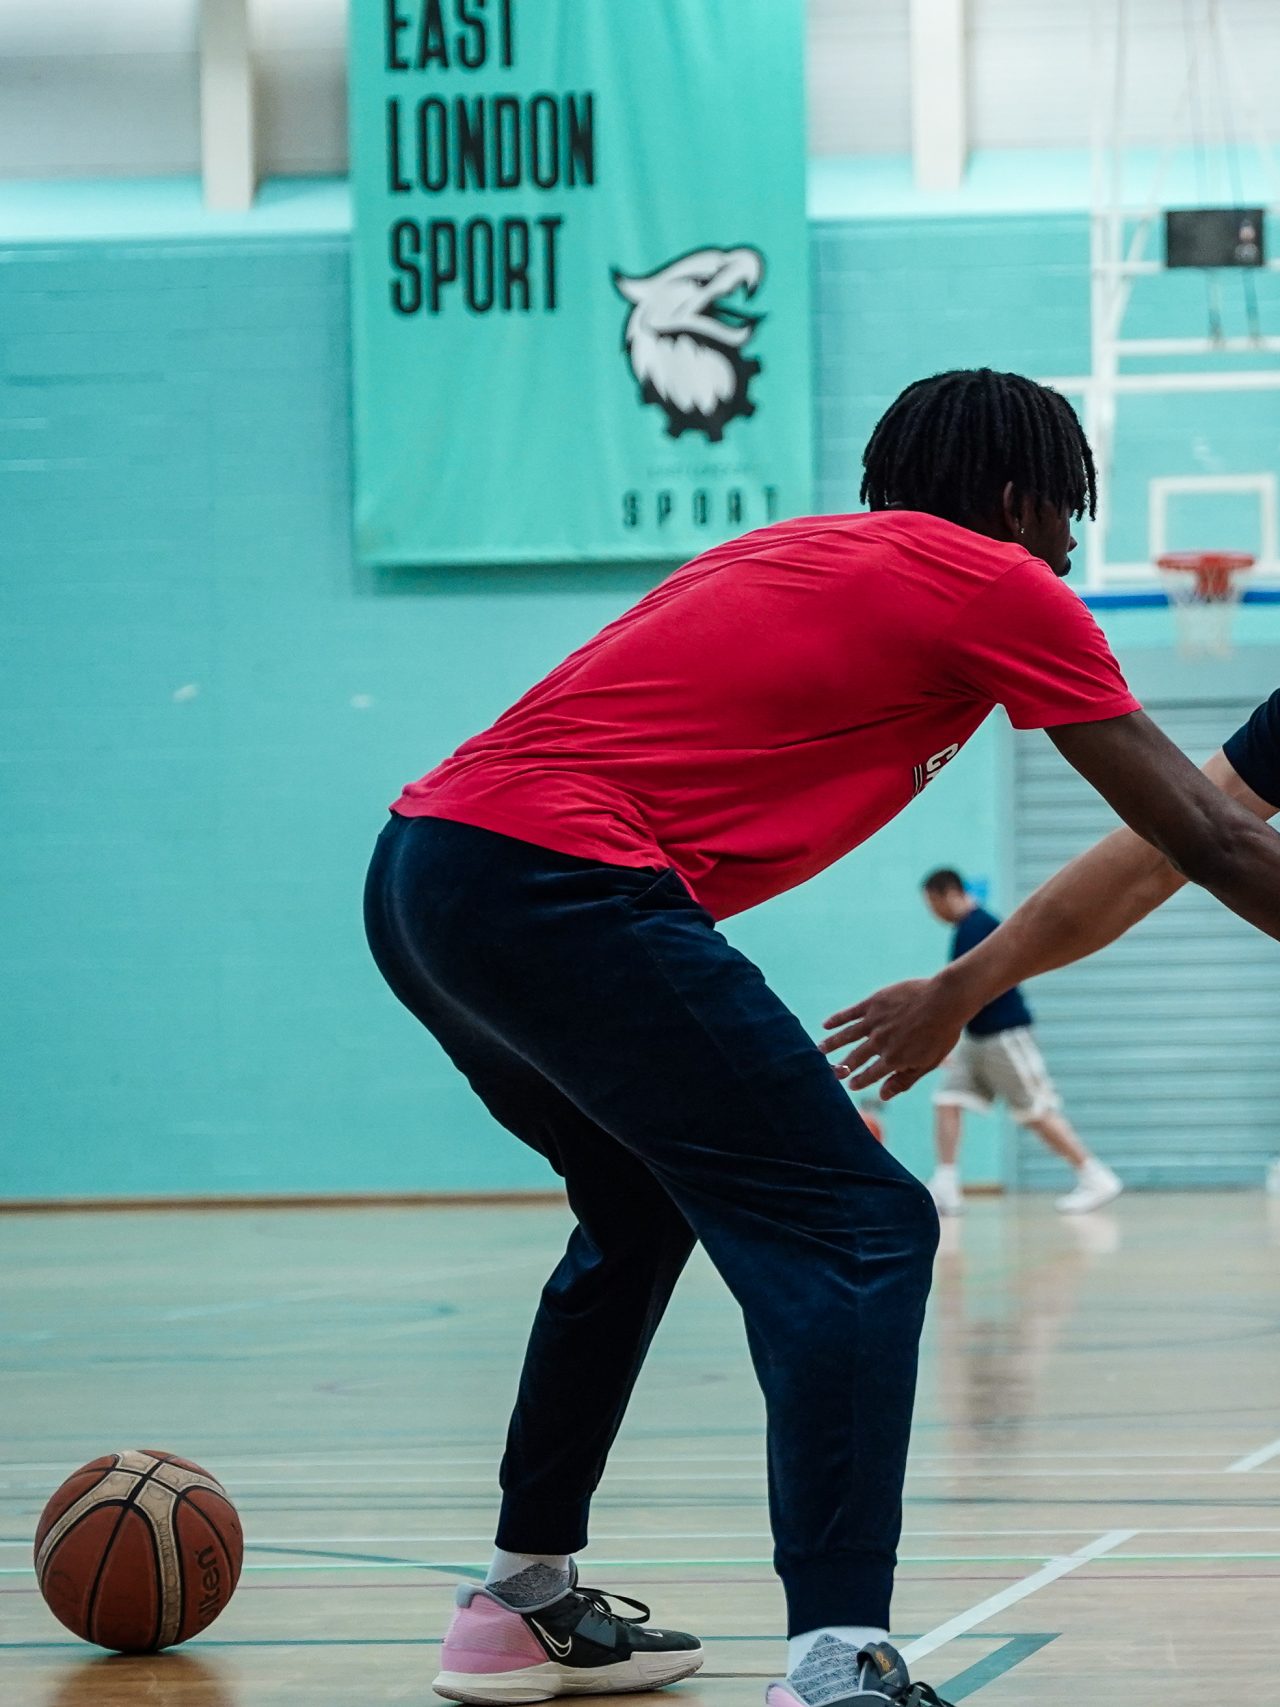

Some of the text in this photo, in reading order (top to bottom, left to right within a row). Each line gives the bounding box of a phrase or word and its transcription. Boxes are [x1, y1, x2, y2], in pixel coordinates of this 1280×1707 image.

[385, 0, 514, 70] EAST
[387, 91, 597, 192] LONDON
[390, 216, 564, 315] SPORT
[622, 485, 779, 528] SPORT
